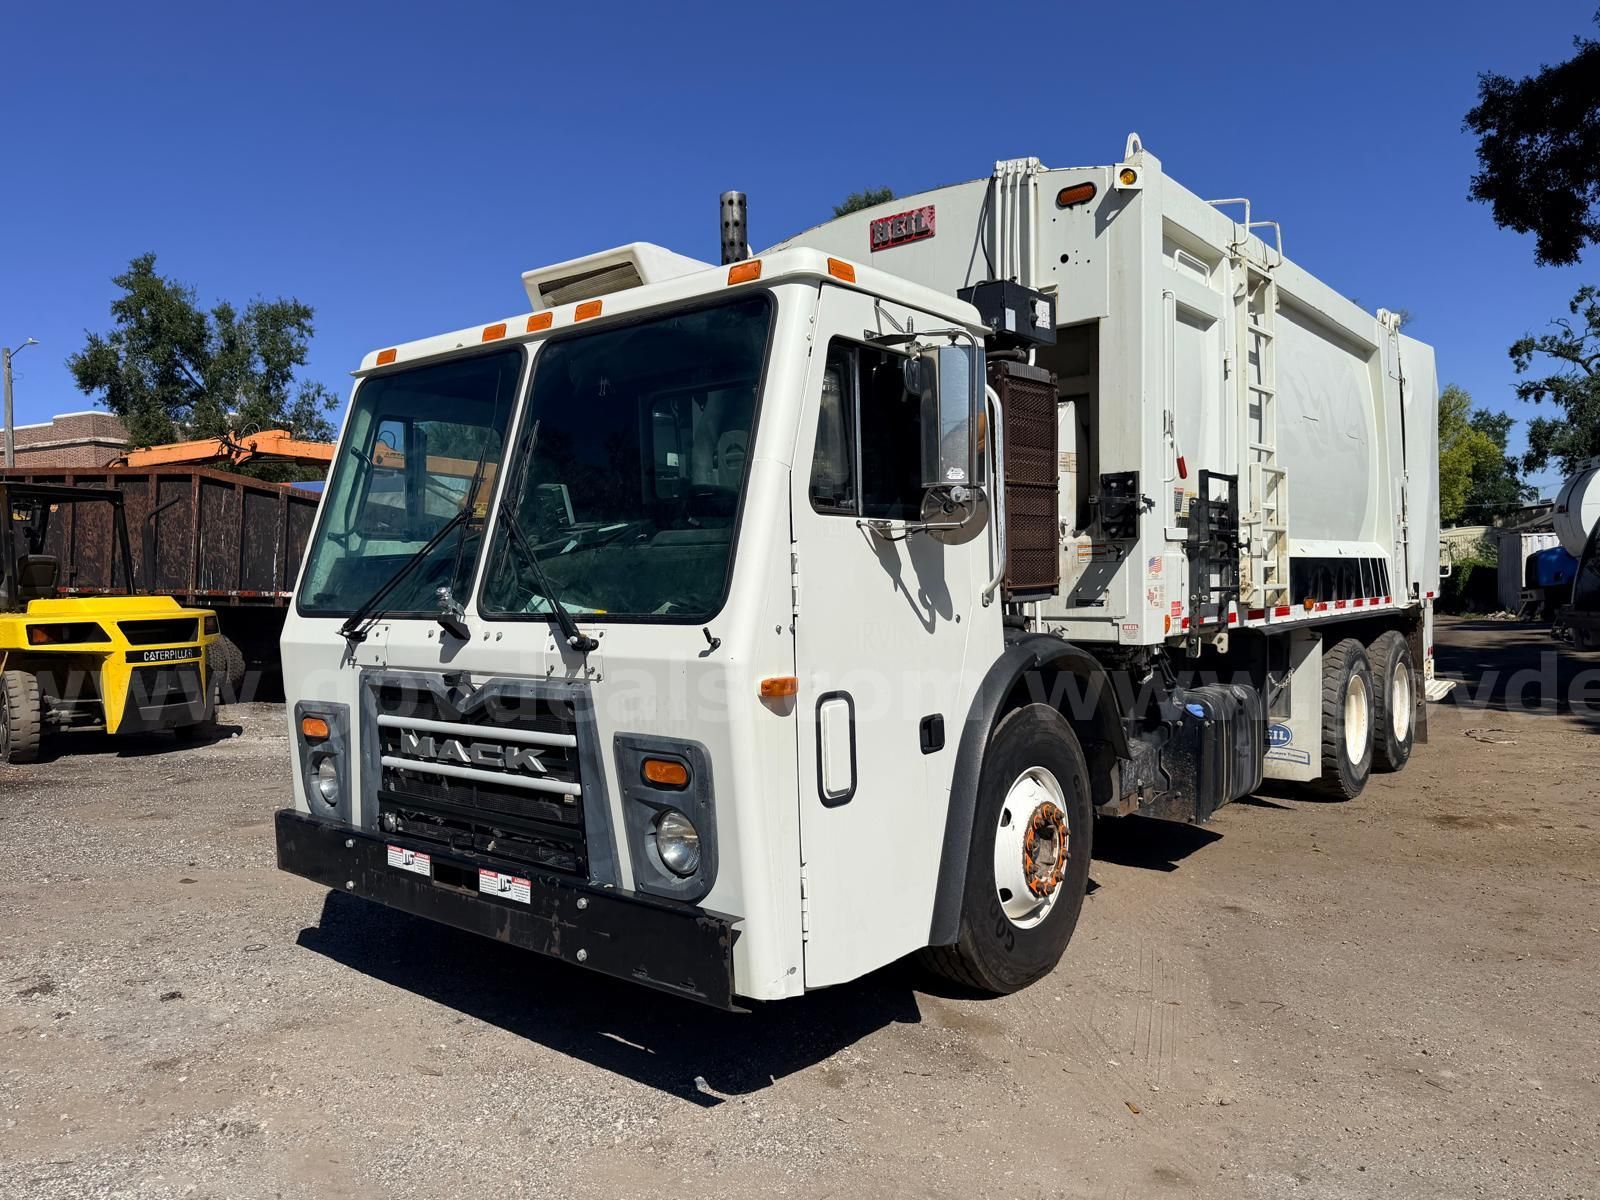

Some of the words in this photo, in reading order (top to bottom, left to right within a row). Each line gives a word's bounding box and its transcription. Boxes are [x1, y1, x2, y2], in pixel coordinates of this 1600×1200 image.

[873, 210, 931, 244] HEIL
[143, 648, 193, 661] CATERPILLAR
[1265, 729, 1287, 740] EIL
[400, 731, 548, 772] MACK
